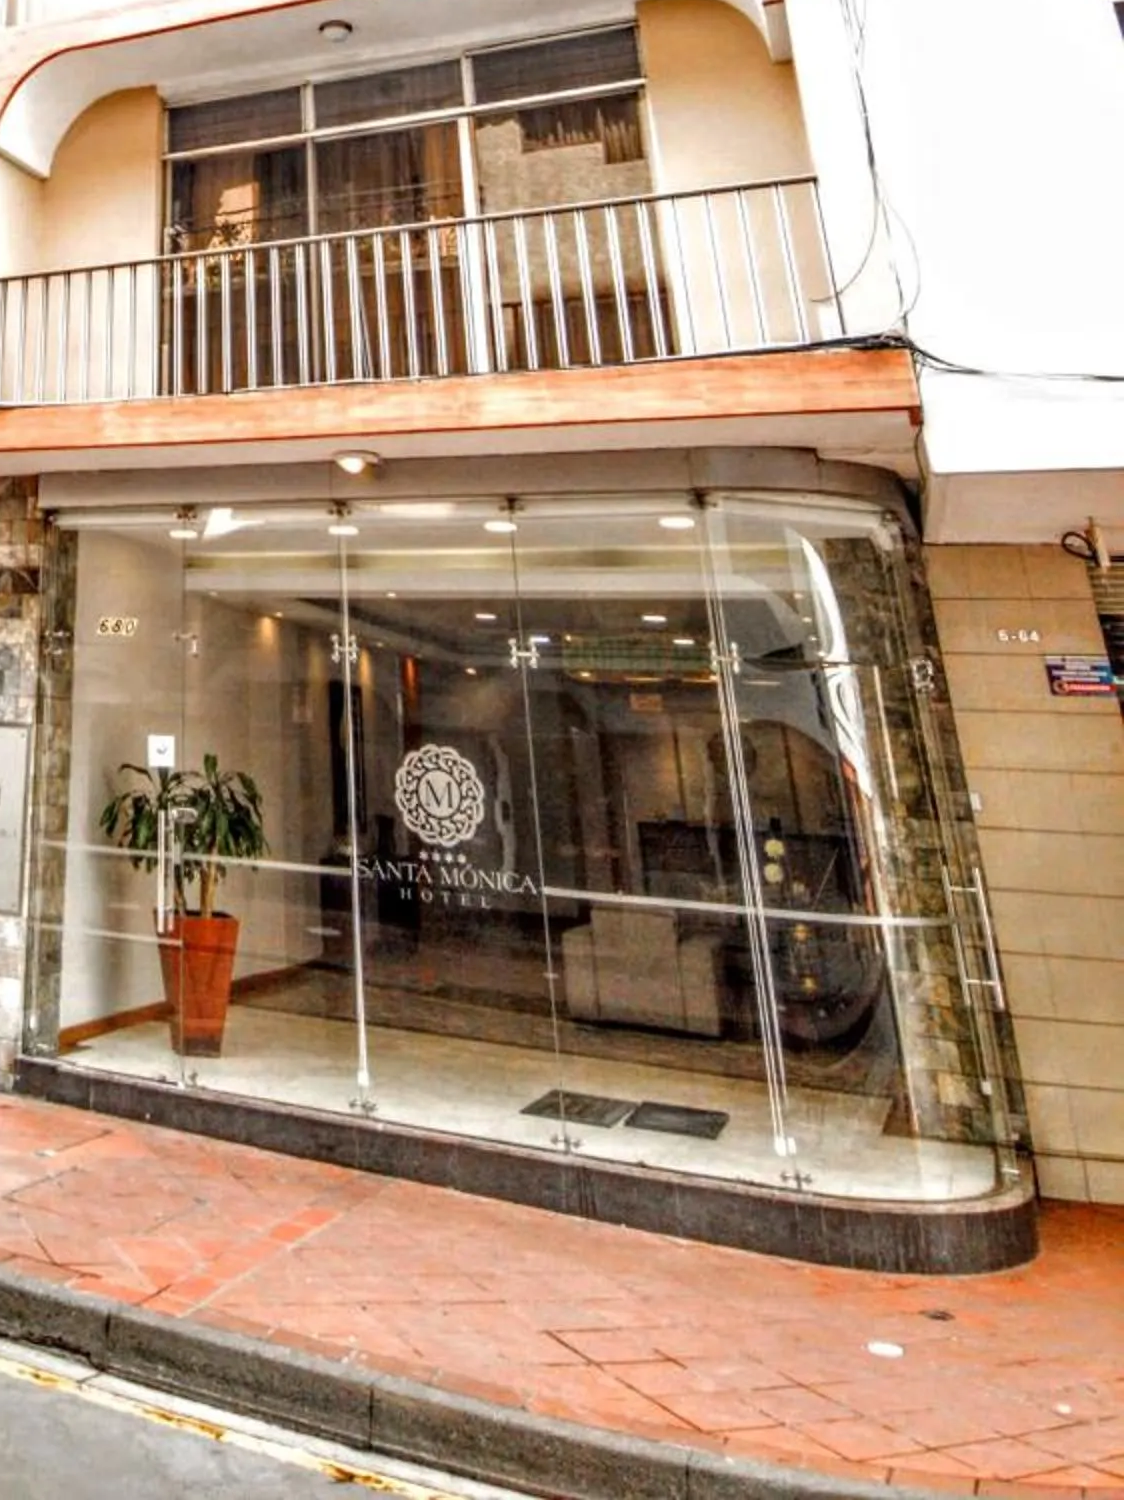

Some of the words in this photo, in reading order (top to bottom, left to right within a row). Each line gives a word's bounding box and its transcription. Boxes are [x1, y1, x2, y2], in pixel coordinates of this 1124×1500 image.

[426, 781, 453, 809] M
[356, 858, 433, 885] SANTA
[439, 864, 539, 896] MÓNICA
[399, 888, 492, 909] HOTEL
